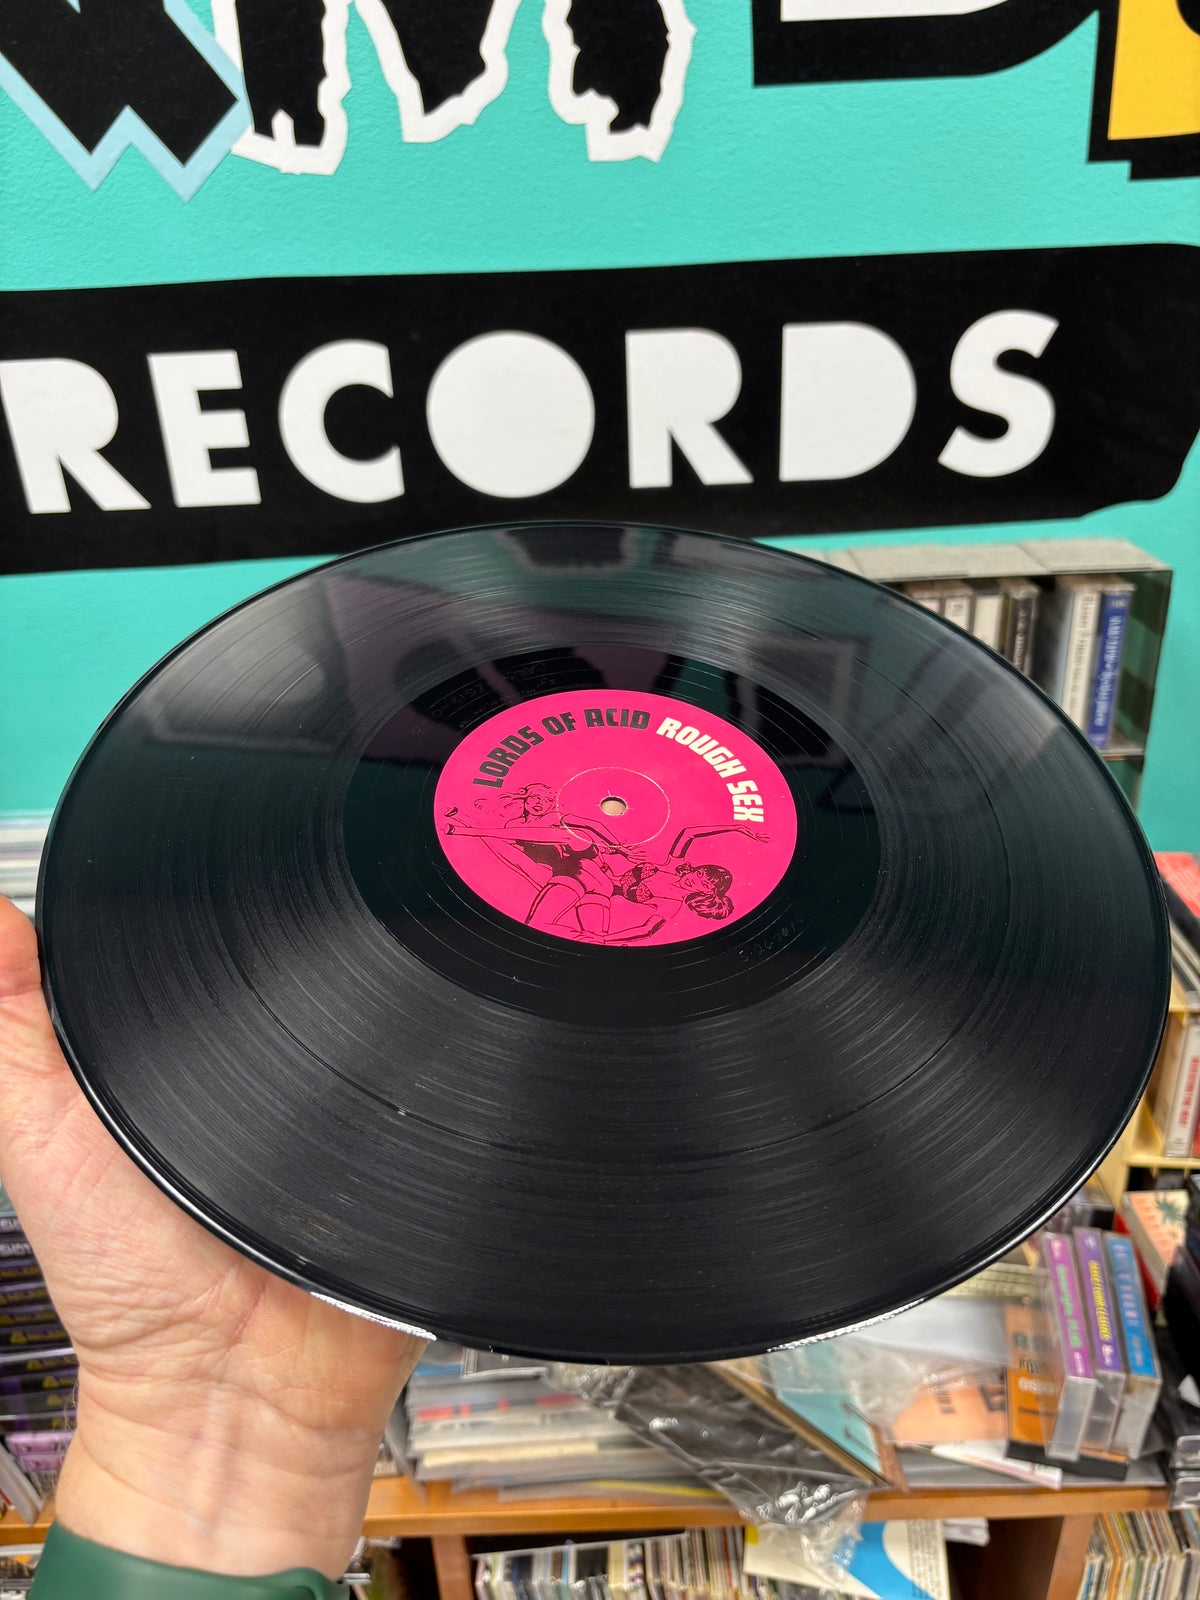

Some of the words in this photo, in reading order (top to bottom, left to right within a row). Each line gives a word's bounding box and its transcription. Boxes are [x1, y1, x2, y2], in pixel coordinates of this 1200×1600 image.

[0, 309, 1059, 513] RECORDS
[473, 725, 544, 788] LORDS
[541, 711, 577, 736] OF
[583, 708, 651, 730] ACID
[656, 717, 747, 779] ROUGH
[726, 782, 765, 823] SEX
